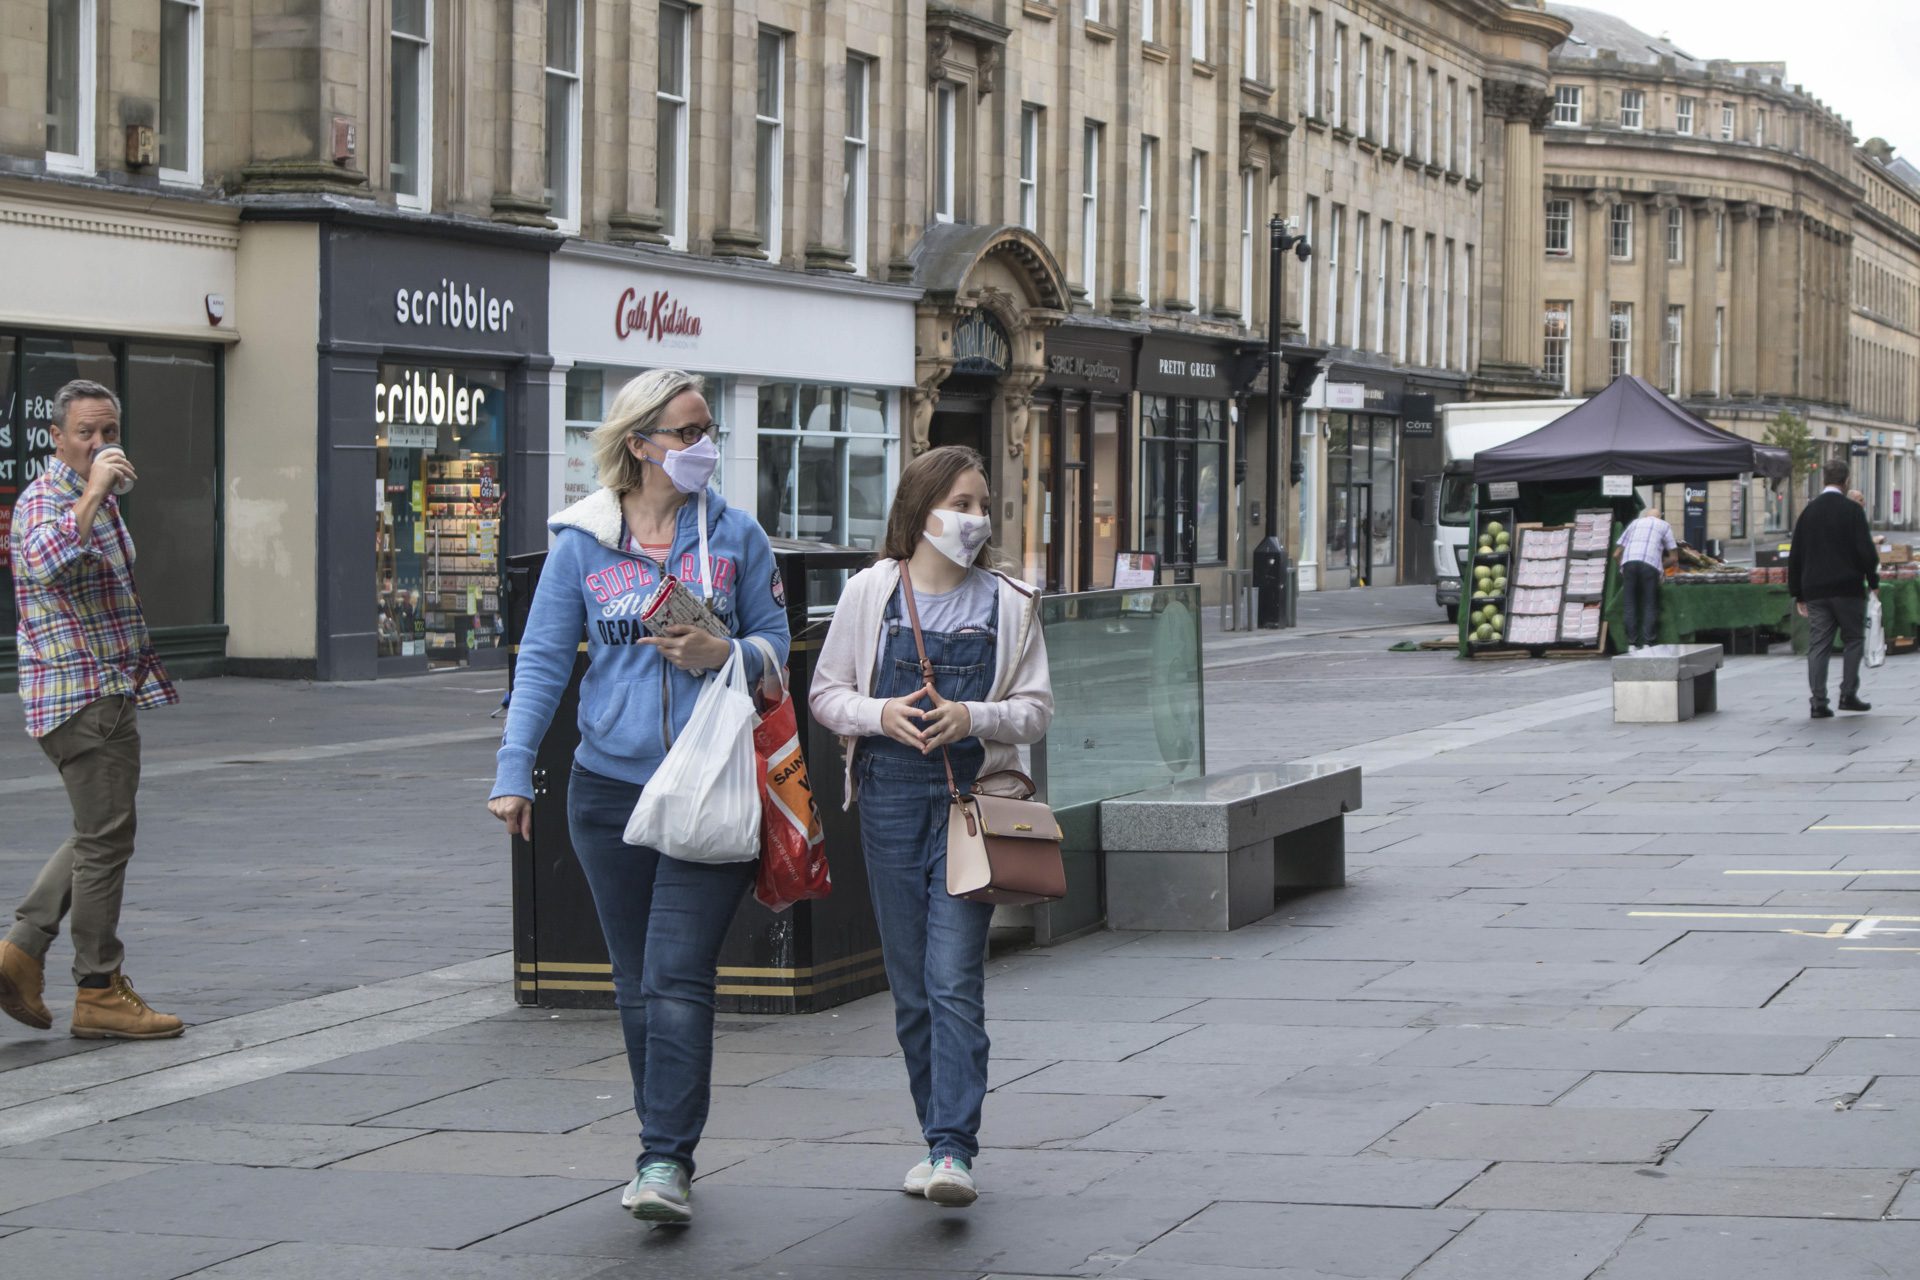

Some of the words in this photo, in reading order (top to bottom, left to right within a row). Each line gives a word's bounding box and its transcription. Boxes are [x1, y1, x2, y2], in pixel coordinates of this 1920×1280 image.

[396, 277, 515, 333] scribbler
[615, 286, 649, 340] Cath
[647, 290, 703, 344] Kidston
[1159, 358, 1187, 376] PRETTY
[1190, 361, 1216, 378] GREEN
[585, 552, 737, 604] SUPERR
